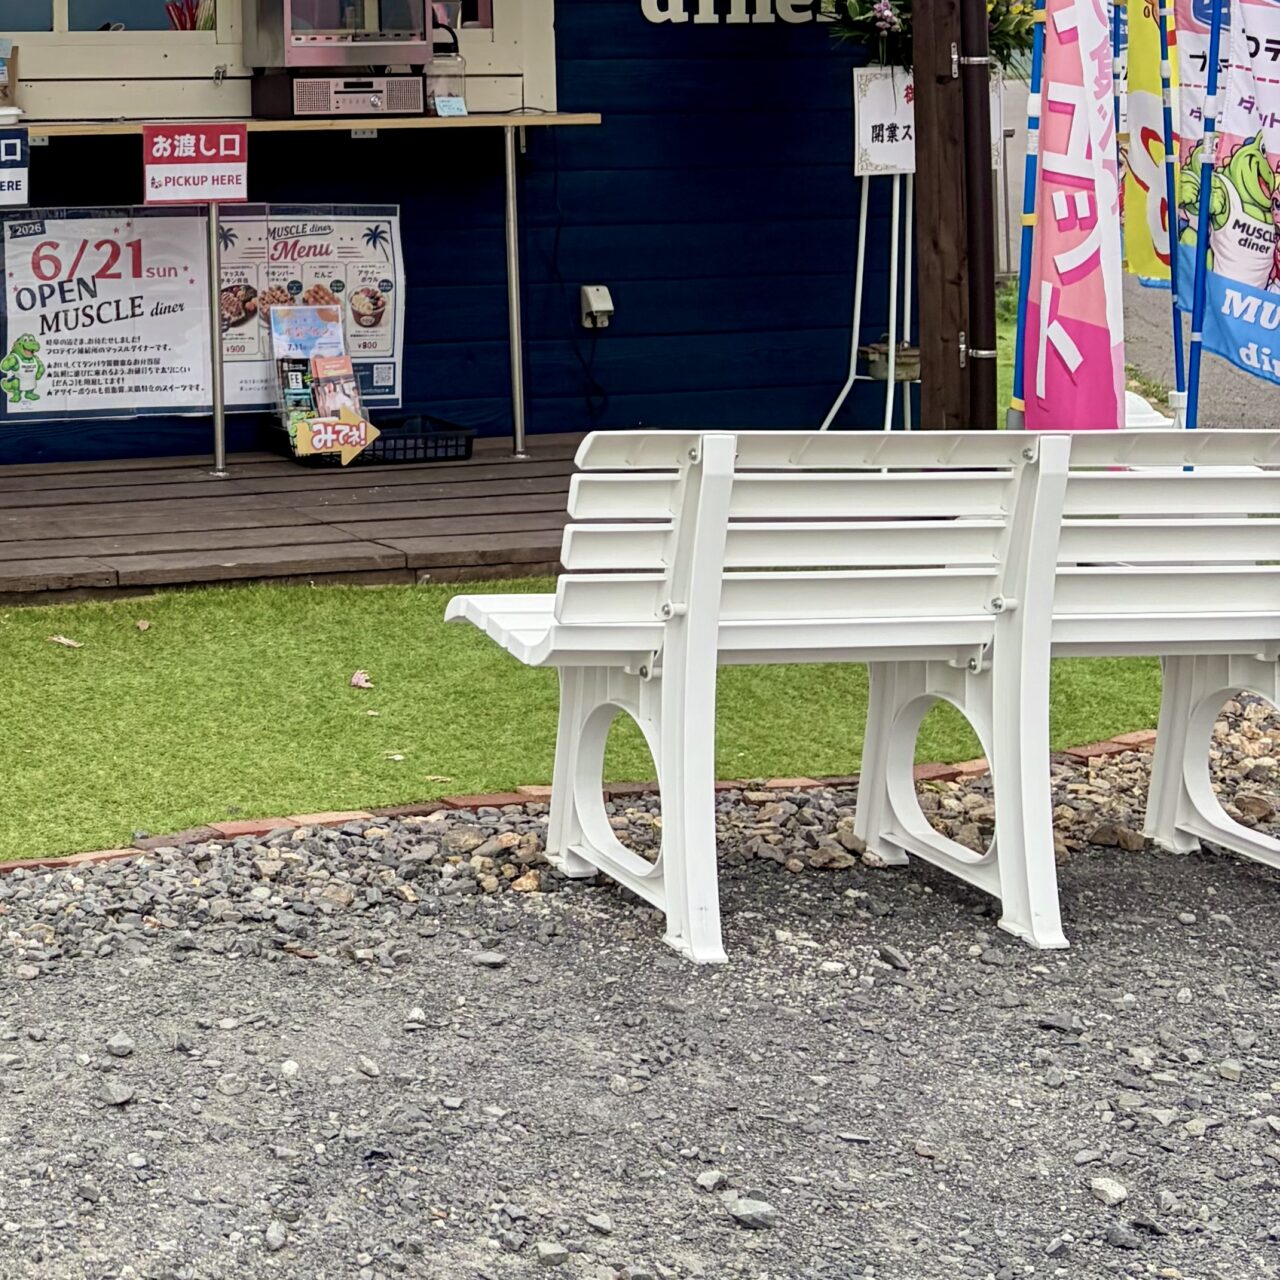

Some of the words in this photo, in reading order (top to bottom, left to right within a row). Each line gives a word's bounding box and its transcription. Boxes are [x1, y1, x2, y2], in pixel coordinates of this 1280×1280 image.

[152, 134, 240, 157] お渡し口
[164, 176, 208, 187] PICKUP
[211, 174, 242, 185] HERE
[15, 224, 42, 236] 2026
[268, 223, 308, 240] MUSCLE
[270, 240, 333, 261] Menu
[1238, 236, 1271, 254] diner
[31, 238, 143, 282] 6/21
[146, 267, 178, 278] sun
[15, 275, 98, 312] OPEN
[39, 296, 145, 336] MUSCLE
[150, 301, 185, 317] diner
[312, 422, 367, 448] みてね!
